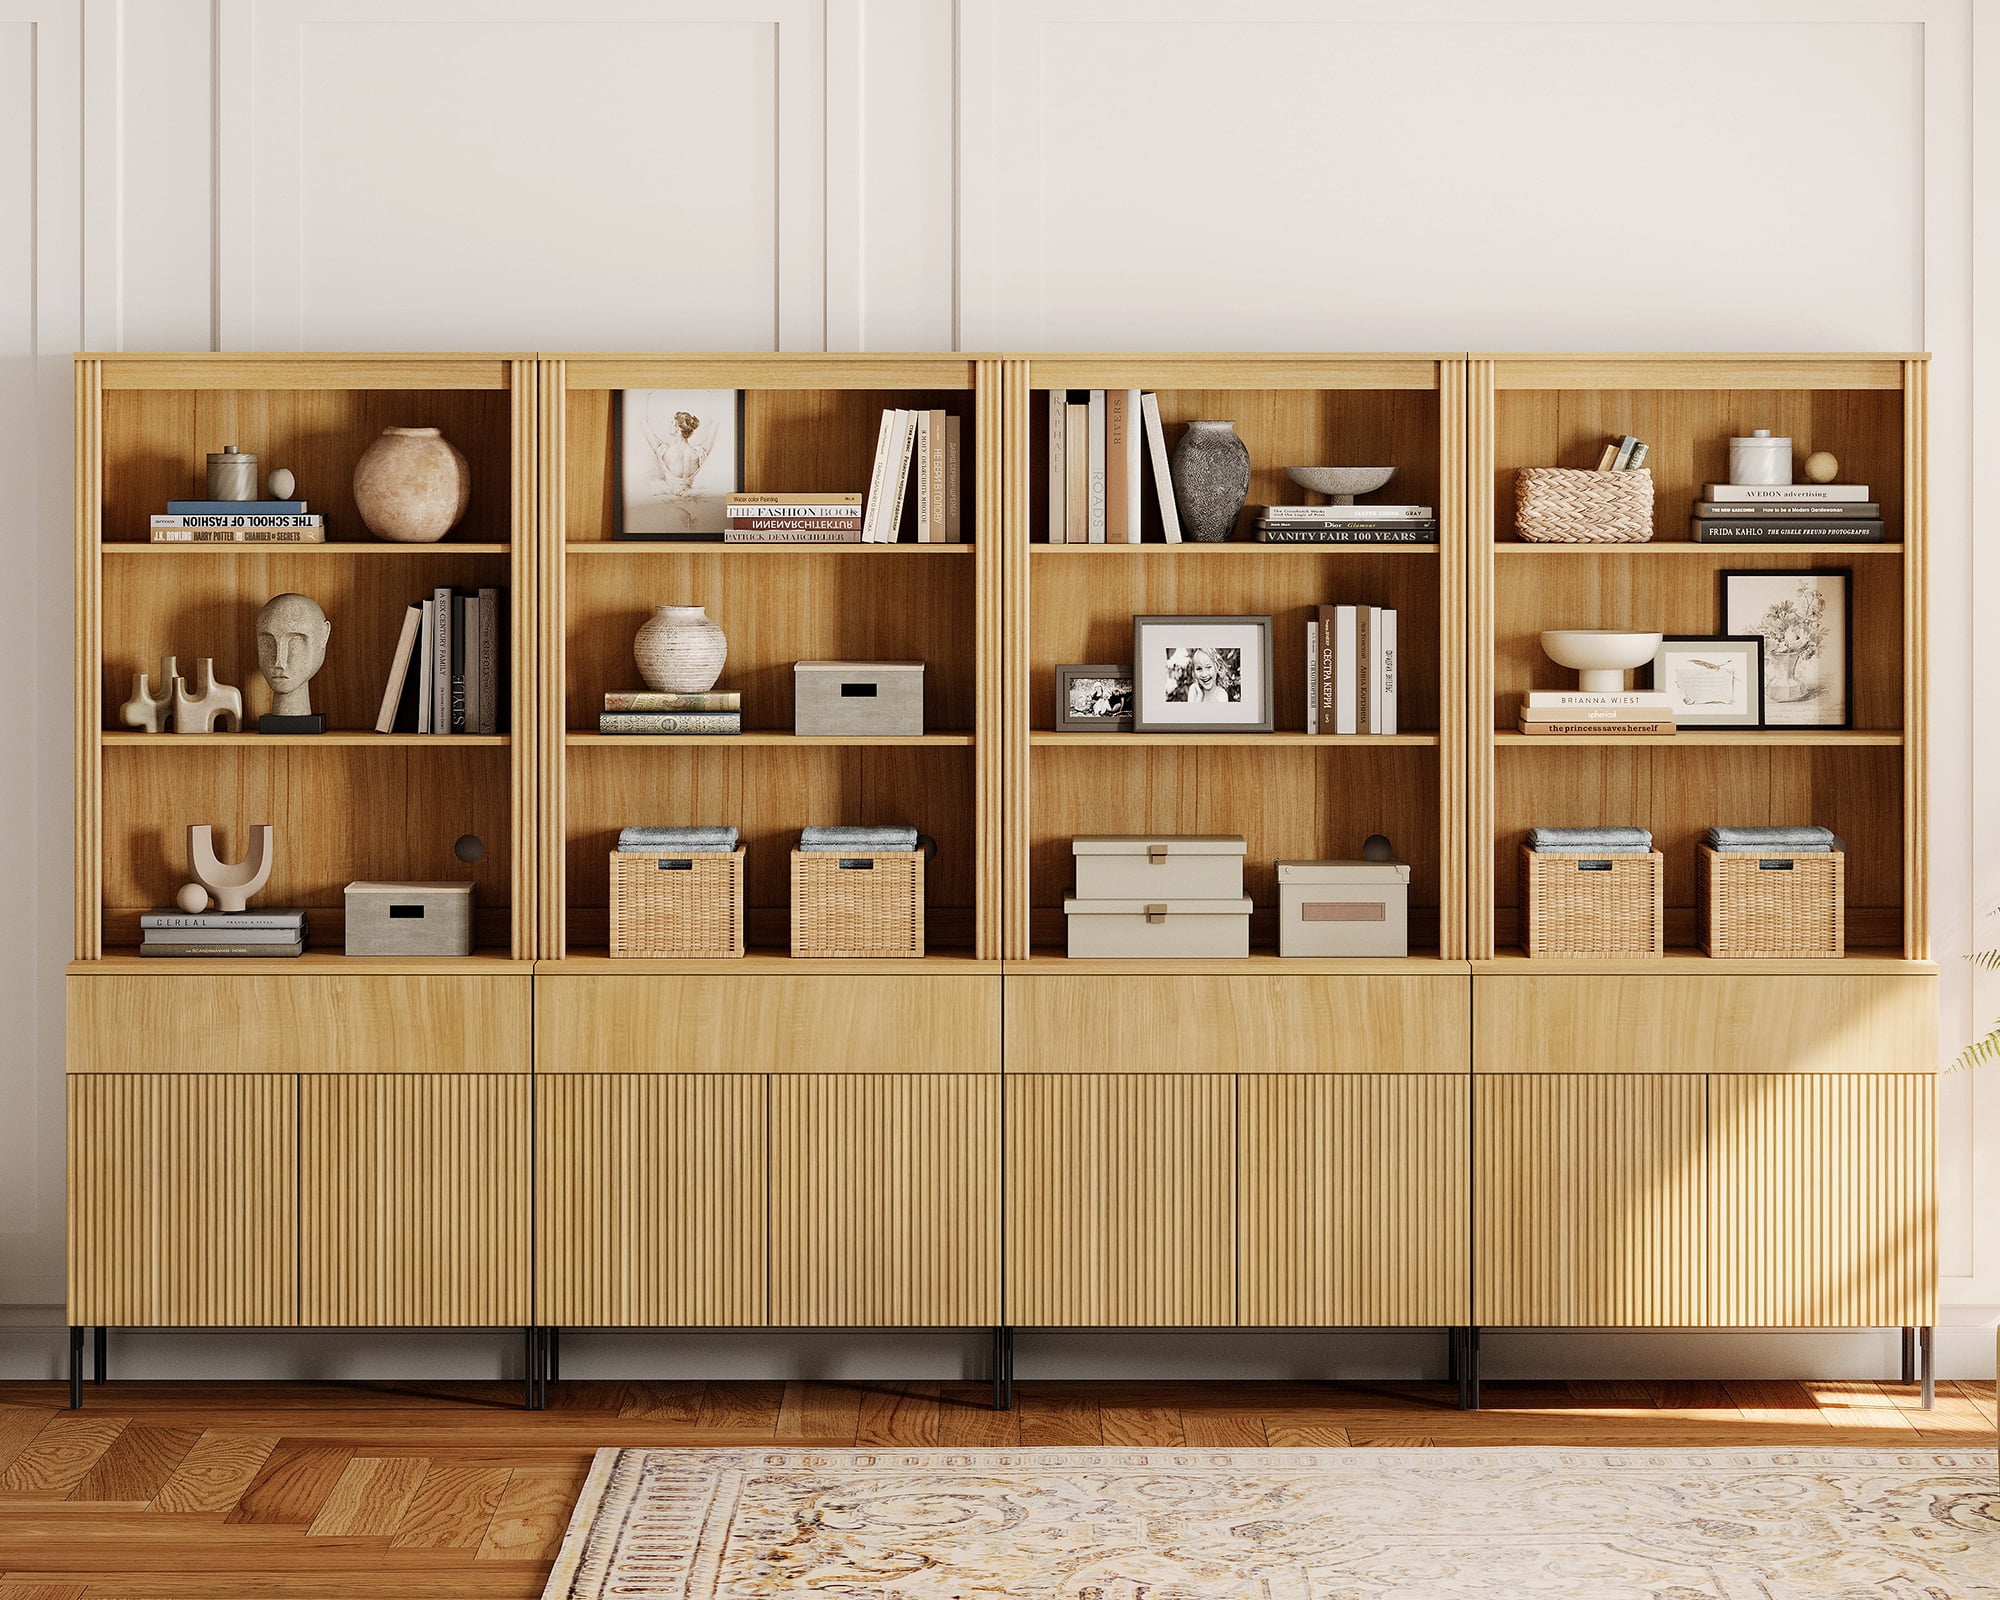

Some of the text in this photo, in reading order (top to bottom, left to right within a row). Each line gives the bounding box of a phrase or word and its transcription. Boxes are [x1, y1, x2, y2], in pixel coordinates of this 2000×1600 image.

[1114, 399, 1122, 445] RIVERS
[1053, 396, 1061, 473] RAPHAEL
[934, 448, 942, 459] НЕ
[934, 460, 942, 482] БЕРИ
[1093, 471, 1104, 528] ROADS
[728, 508, 755, 517] THE
[758, 508, 816, 517] FASHION
[934, 491, 942, 523] ГОЛОВУ
[182, 516, 313, 527] THE SCHOOL OF FASHION
[154, 531, 165, 541] J.K.
[193, 531, 212, 541] HARRY
[213, 531, 234, 541] POTTER
[276, 531, 300, 541] SECRETS
[725, 533, 844, 541] PATRICK DEMARCHELIER
[1268, 532, 1416, 541] VANITY FAIR 100 YEARS
[1709, 528, 1763, 536] FRIDA KAHLO
[1323, 648, 1332, 709] СЕСТРА КЕРРИ
[453, 675, 465, 725] STYLE
[1564, 725, 1602, 733] princess
[1627, 724, 1659, 732] herself
[156, 918, 207, 926] CEREAL
